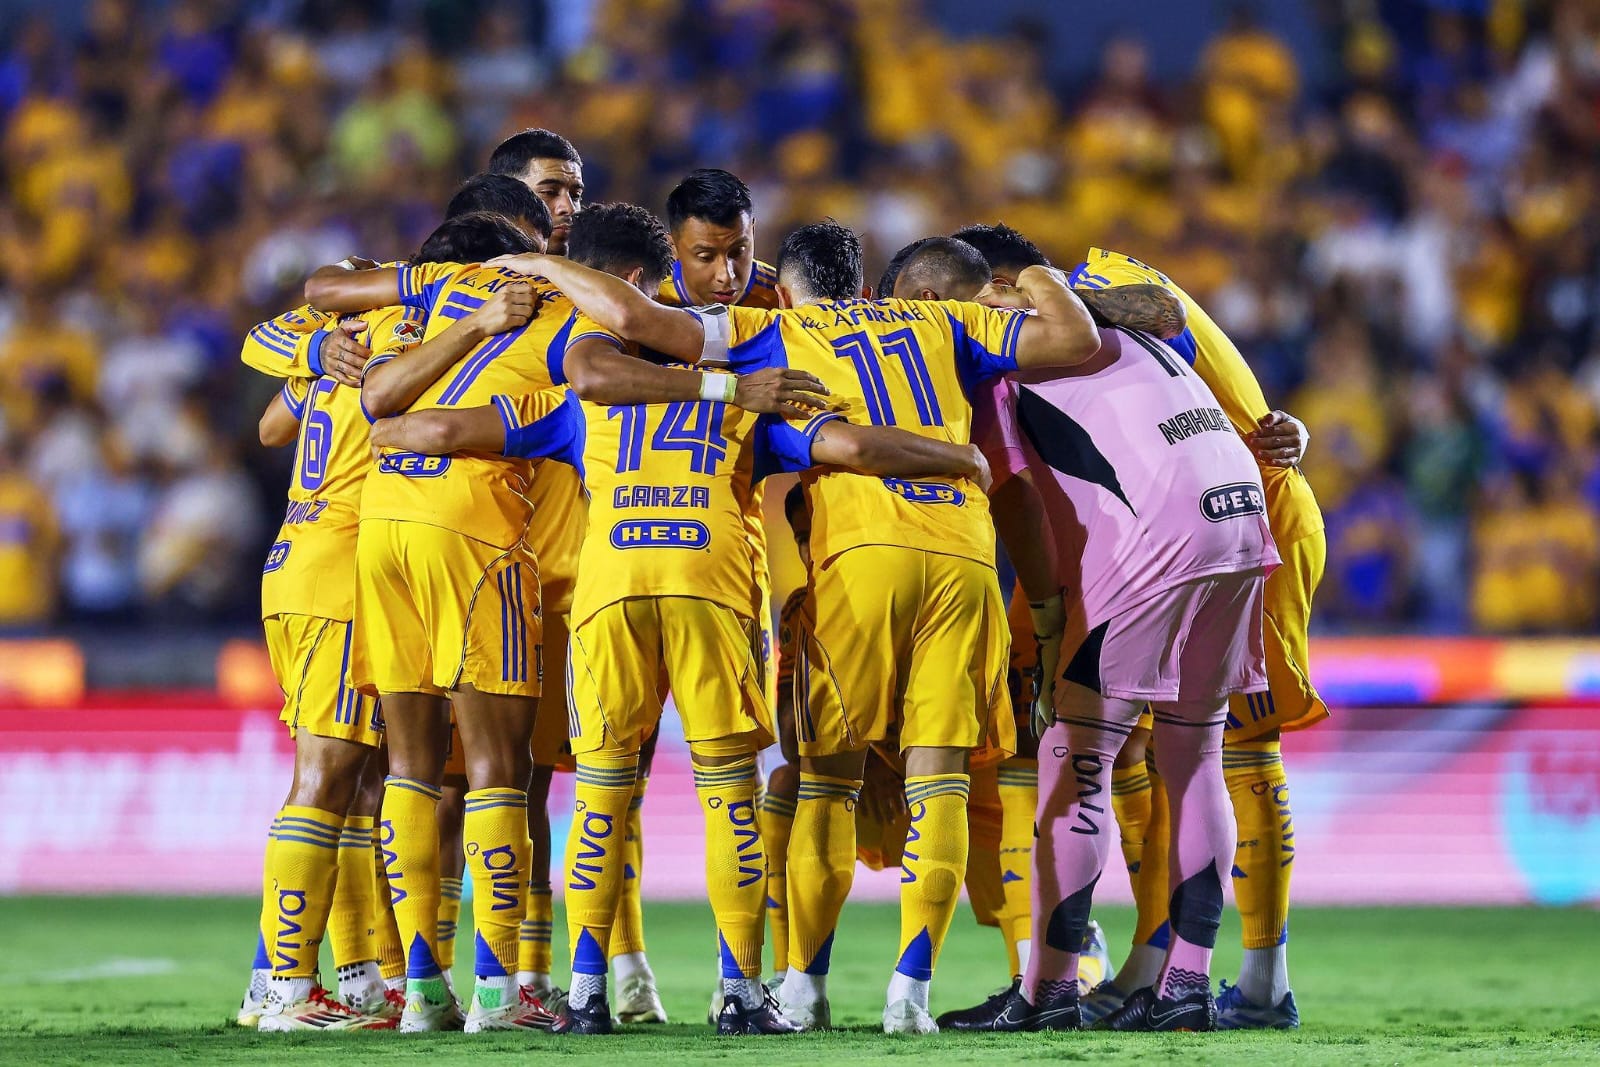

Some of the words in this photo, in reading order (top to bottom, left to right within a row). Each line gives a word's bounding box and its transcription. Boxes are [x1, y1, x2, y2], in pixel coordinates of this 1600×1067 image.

[834, 307, 926, 327] AFIRME
[829, 327, 944, 428] 11
[607, 399, 728, 476] 14
[613, 485, 710, 509] GARZA
[1070, 753, 1104, 836] viva
[568, 810, 614, 891] viva
[727, 799, 764, 888] viva
[275, 889, 307, 972] viva
